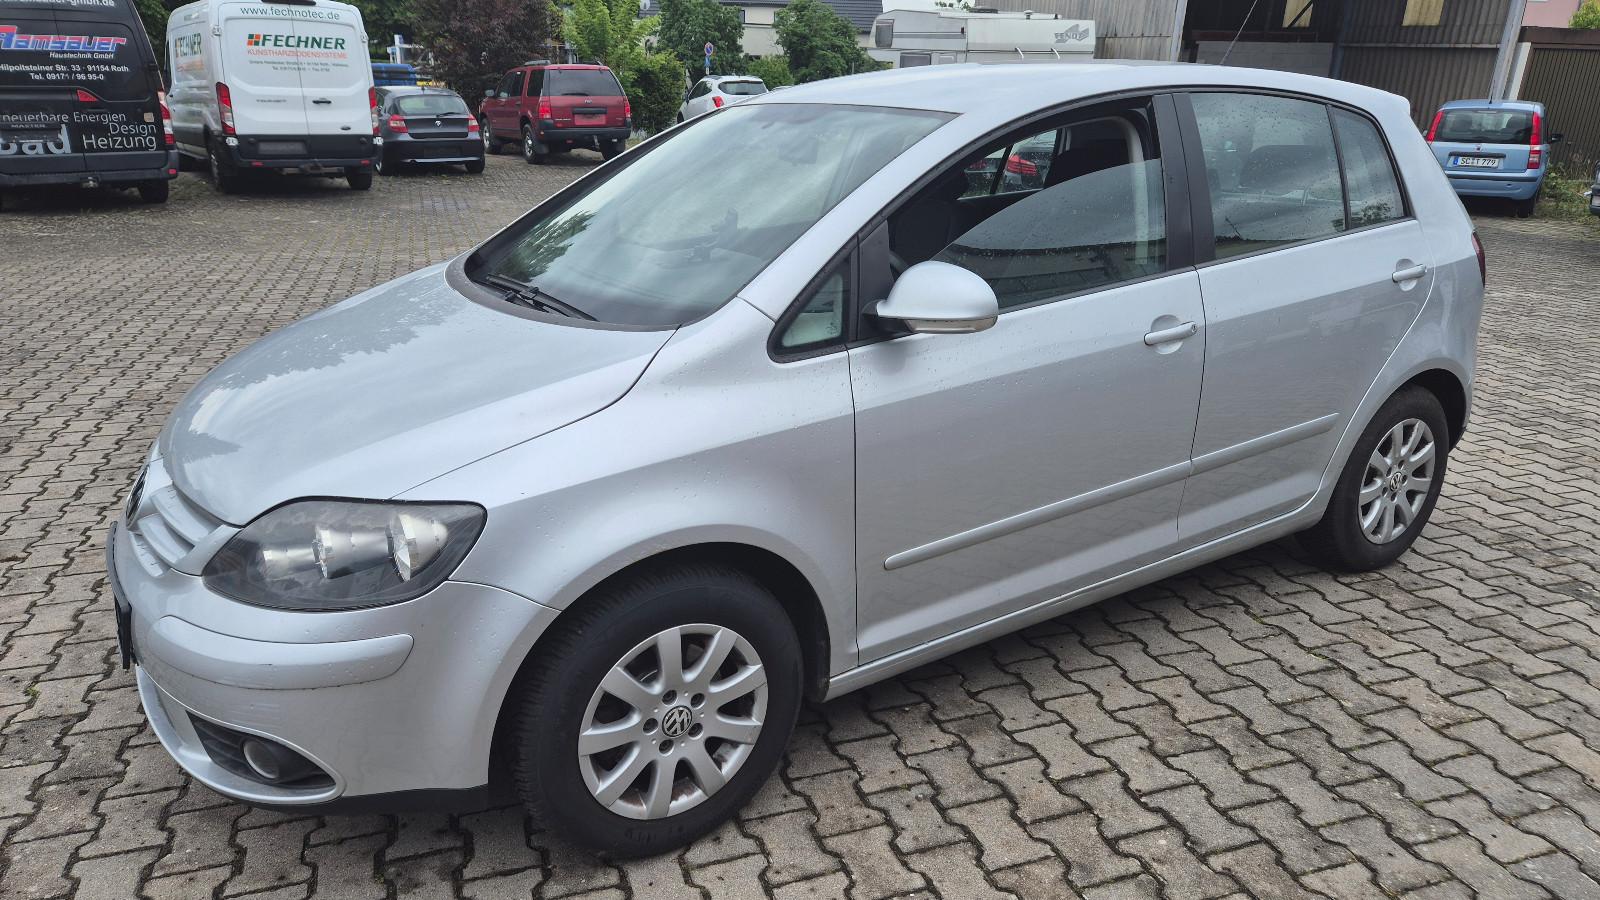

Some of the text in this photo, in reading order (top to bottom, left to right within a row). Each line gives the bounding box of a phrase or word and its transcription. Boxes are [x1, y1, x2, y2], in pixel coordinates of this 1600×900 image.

[240, 7, 340, 20] www.fechnotec.de
[261, 34, 346, 50] FECHNER
[49, 51, 92, 59] Haustechnik
[73, 112, 126, 123] Energien
[109, 122, 157, 136] Design
[82, 134, 157, 151] Heizung
